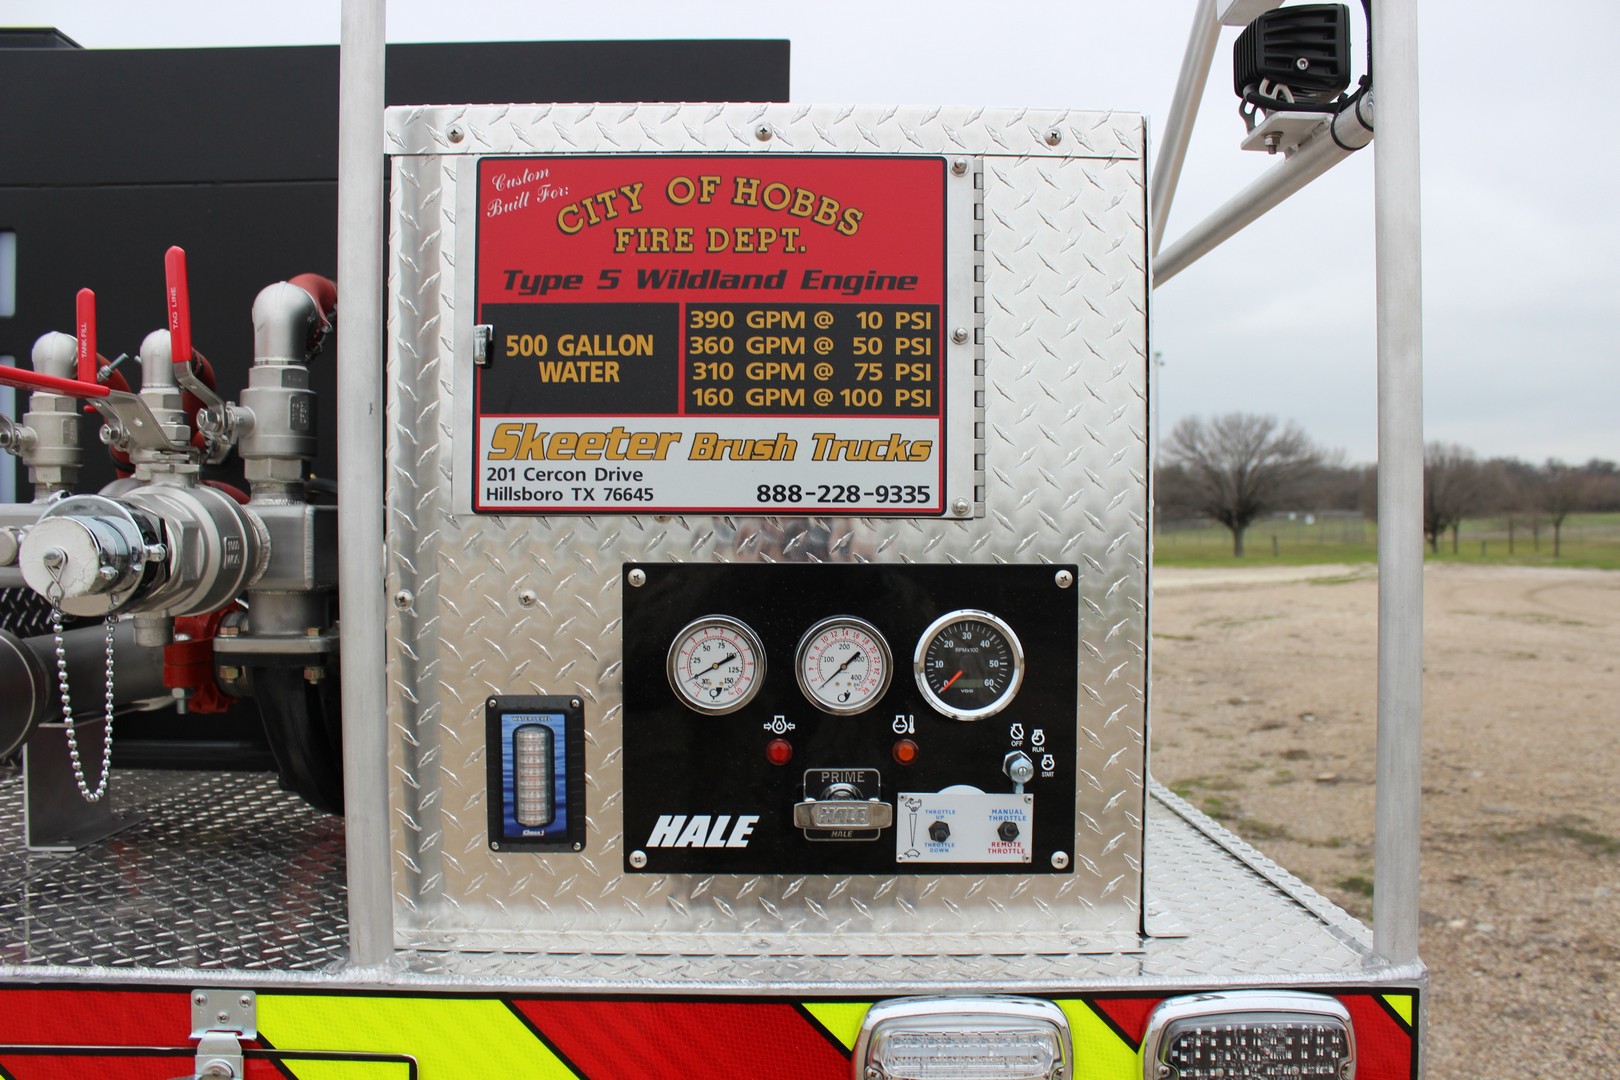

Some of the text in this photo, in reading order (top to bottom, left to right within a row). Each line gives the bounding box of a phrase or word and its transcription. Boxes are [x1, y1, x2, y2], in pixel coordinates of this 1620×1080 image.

[492, 166, 549, 191] Custom
[487, 183, 571, 217] Built For:
[556, 175, 864, 238] CITY OF HOBBS
[613, 227, 806, 254] FIRE DEPT.
[504, 269, 918, 296] Type 5 Wildland Engine
[690, 311, 931, 329] 390 GPM @ 10 PSI
[507, 334, 547, 356] 500
[557, 334, 653, 356] GALLON
[690, 336, 931, 355] 360 GPM @ 50 PSI
[539, 361, 619, 382] WATER
[693, 362, 931, 381] 310 GPM @ 75 PSI
[692, 388, 931, 407] 160 GPM @ 100 PSI
[487, 423, 933, 462] Skeeter Brush Trucks
[487, 467, 643, 481] 201 Cercon Drive
[487, 486, 653, 501] Hillsboro TX 76645
[757, 484, 930, 503] 888-228-9335
[962, 632, 972, 640] 30
[934, 660, 944, 668] 10
[988, 660, 1000, 668] 50
[984, 678, 994, 686] 60
[821, 772, 865, 783] PRIME
[645, 814, 761, 849] HALE
